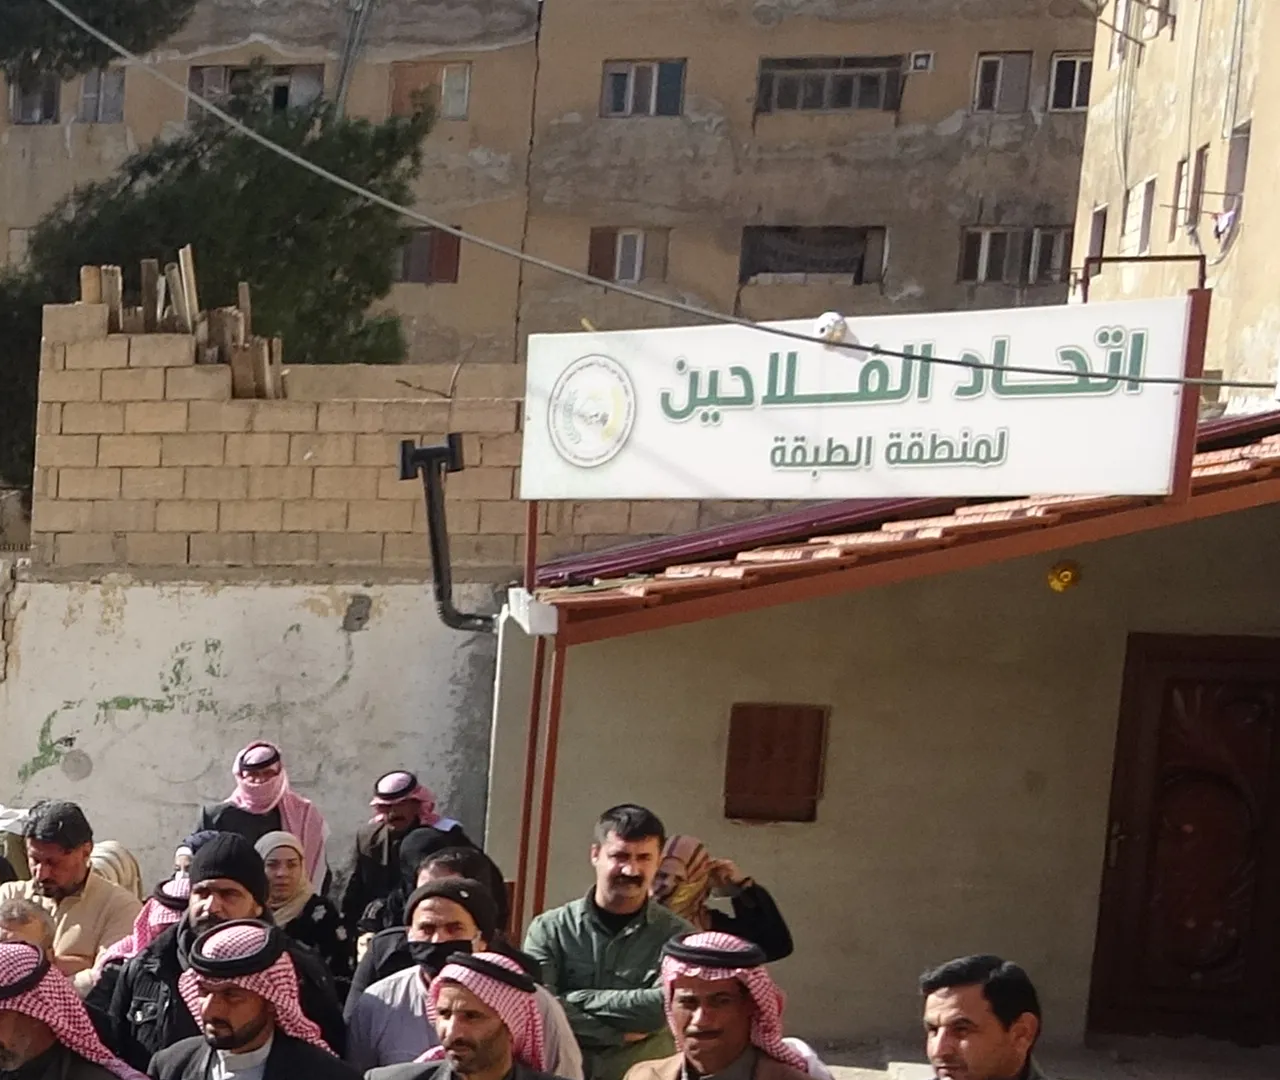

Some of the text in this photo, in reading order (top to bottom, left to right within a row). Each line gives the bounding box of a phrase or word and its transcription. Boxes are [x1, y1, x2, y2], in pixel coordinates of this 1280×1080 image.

[660, 343, 935, 423] الفلاحين
[953, 330, 1146, 397] اتحاد
[770, 431, 1006, 477] لمنطقة الطبقة
